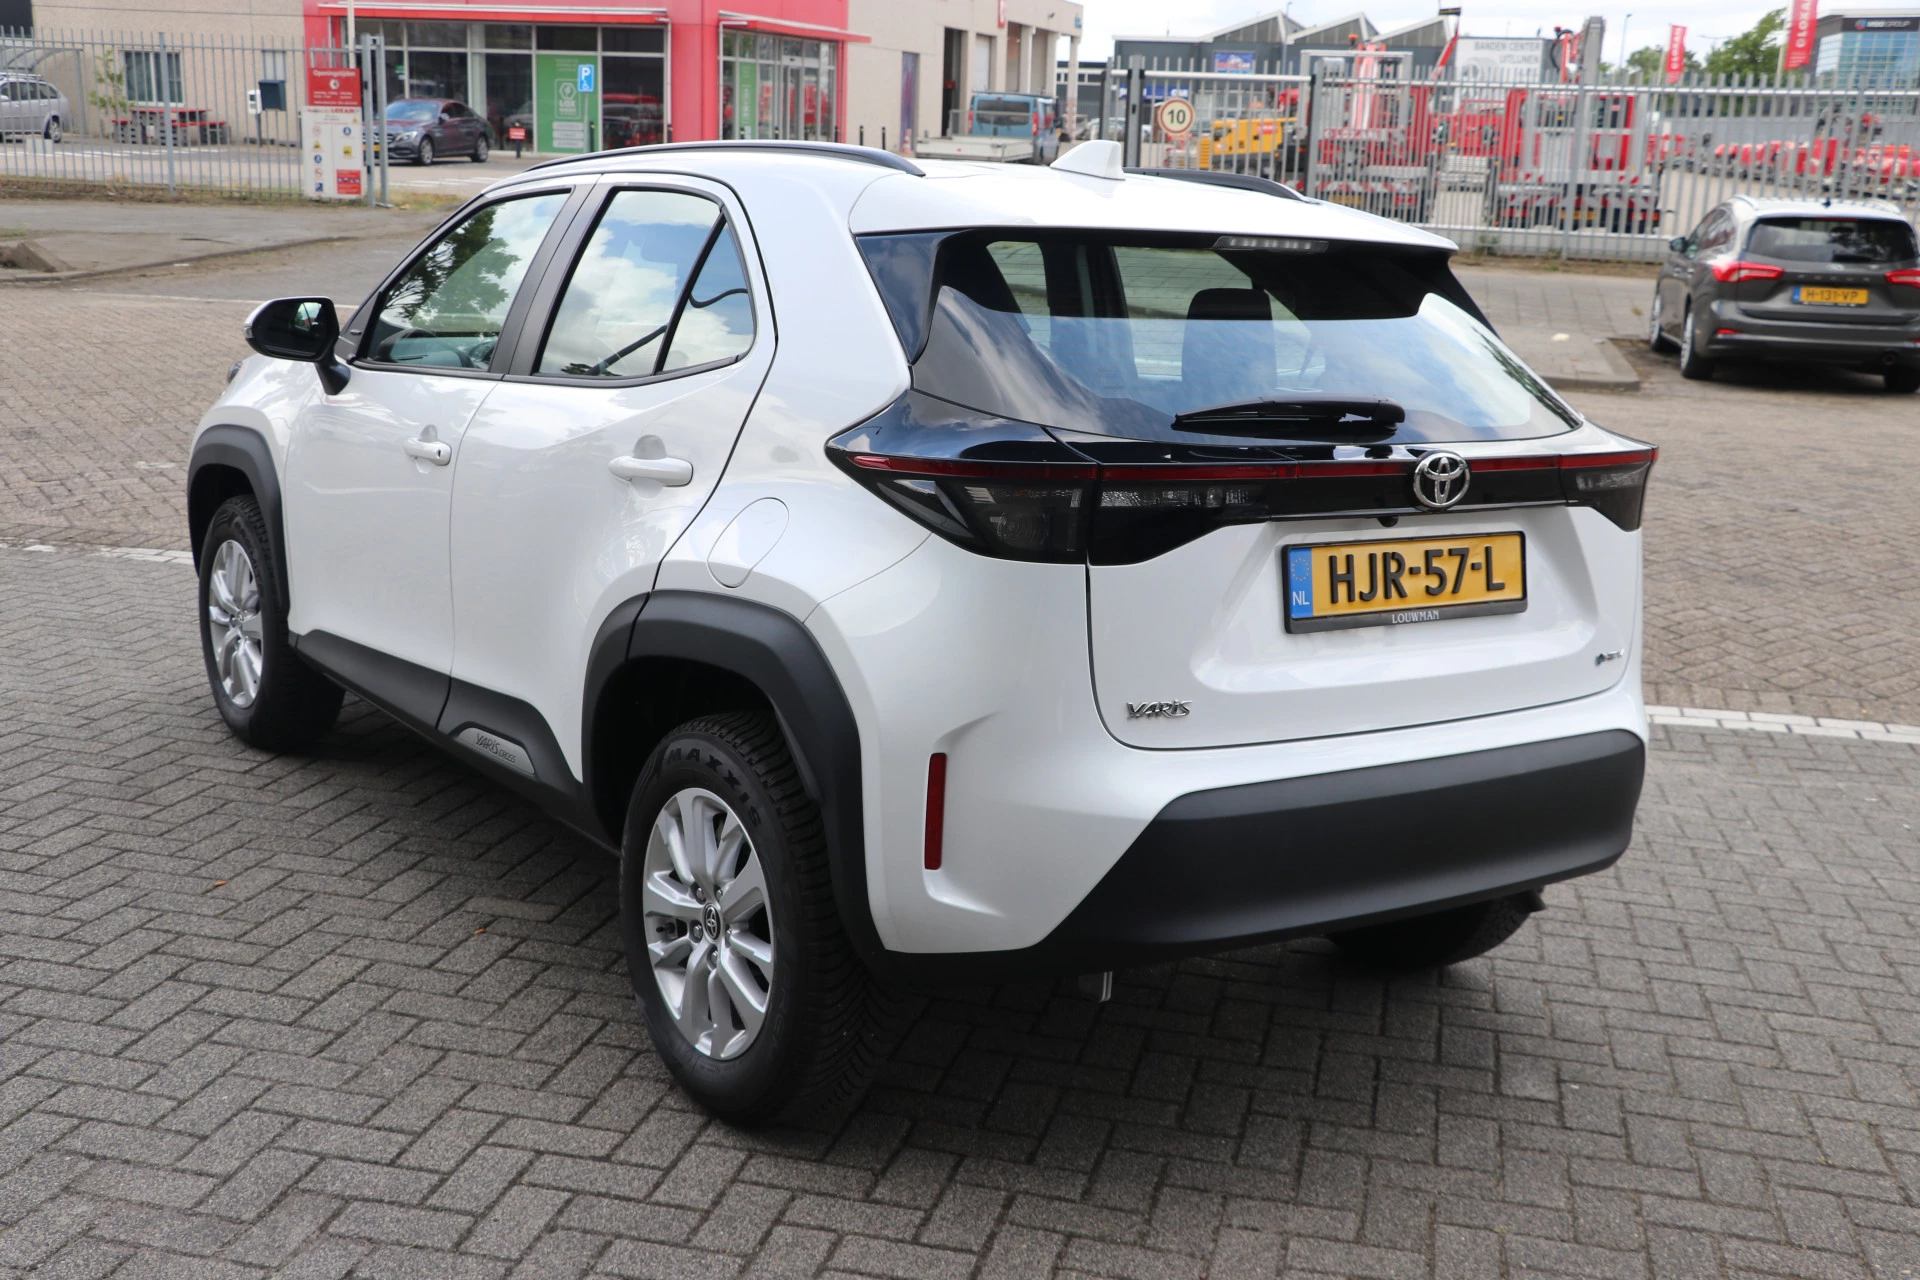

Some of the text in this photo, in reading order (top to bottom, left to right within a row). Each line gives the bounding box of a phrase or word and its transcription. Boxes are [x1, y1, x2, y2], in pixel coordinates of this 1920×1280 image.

[581, 67, 591, 80] P
[1167, 108, 1186, 125] 10
[1328, 545, 1506, 605] HJR-57-L
[1292, 590, 1310, 606] NL
[1391, 609, 1440, 624] LOUWMAN
[475, 732, 500, 755] YARIS
[667, 747, 762, 828] MAXXIS
